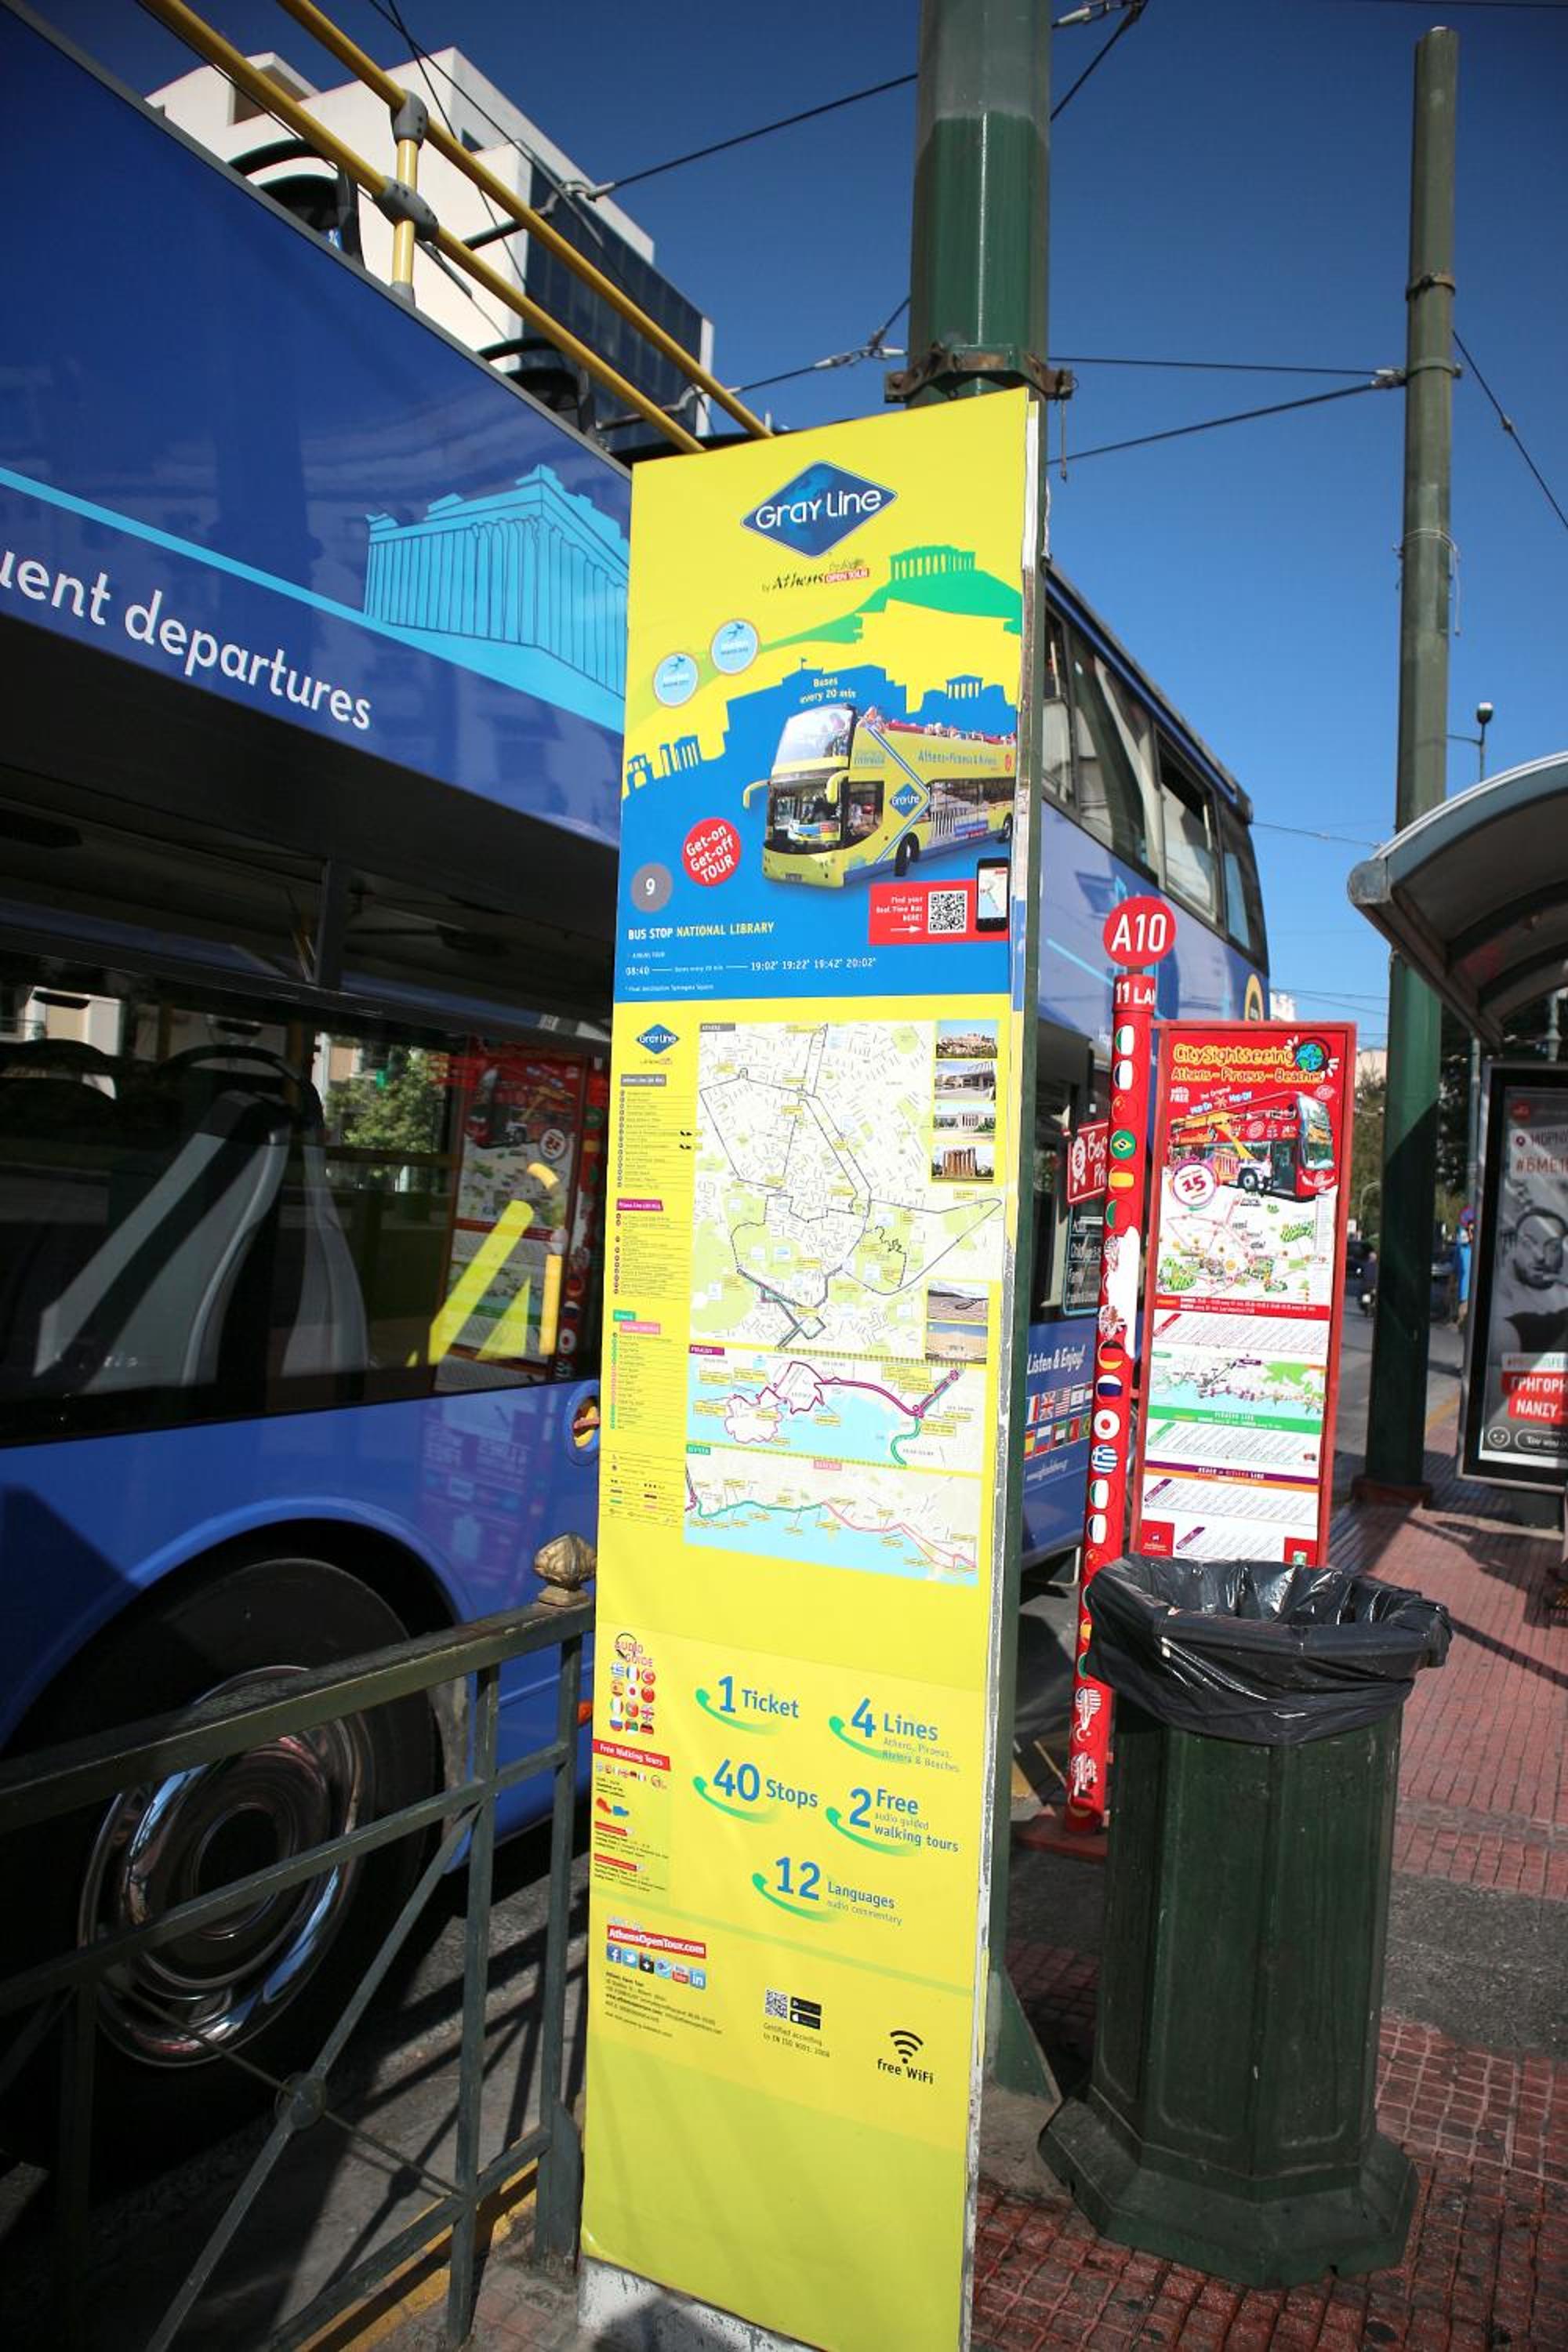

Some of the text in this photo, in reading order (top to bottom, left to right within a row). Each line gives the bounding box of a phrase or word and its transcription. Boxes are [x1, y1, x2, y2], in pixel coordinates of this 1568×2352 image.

[755, 490, 883, 530] Gray Line
[125, 589, 373, 731] departures
[813, 677, 838, 687] Buses
[800, 688, 856, 704] every 20 min
[686, 825, 728, 857] Get-on
[690, 836, 735, 872] Get-off
[700, 855, 735, 882] TOUR
[645, 877, 655, 896] 9
[628, 921, 775, 940] BUS STOP NATIONAL LIBRARY
[1111, 913, 1167, 953] A10
[626, 965, 651, 977] 08:40
[1116, 981, 1131, 1004] 11
[1174, 1044, 1297, 1067] CitySightseeing
[1171, 1068, 1325, 1083] Athens Piraeus Beaches
[1181, 1174, 1207, 1194] 15
[1026, 1344, 1086, 1375] Listen & Enjoy!
[719, 1675, 800, 1719] 1 Ticket
[851, 1697, 939, 1742] 4 Lines
[600, 1743, 615, 1754] Free
[615, 1747, 644, 1762] Walking
[713, 1758, 818, 1809] 40 Stops
[849, 1787, 920, 1829] 2 Free
[874, 1812, 930, 1831] audio guided
[874, 1824, 959, 1853] walking tours
[775, 1856, 895, 1909] 12 Languages
[826, 1899, 902, 1926] audio commentary
[877, 2058, 935, 2085] free WiFi
